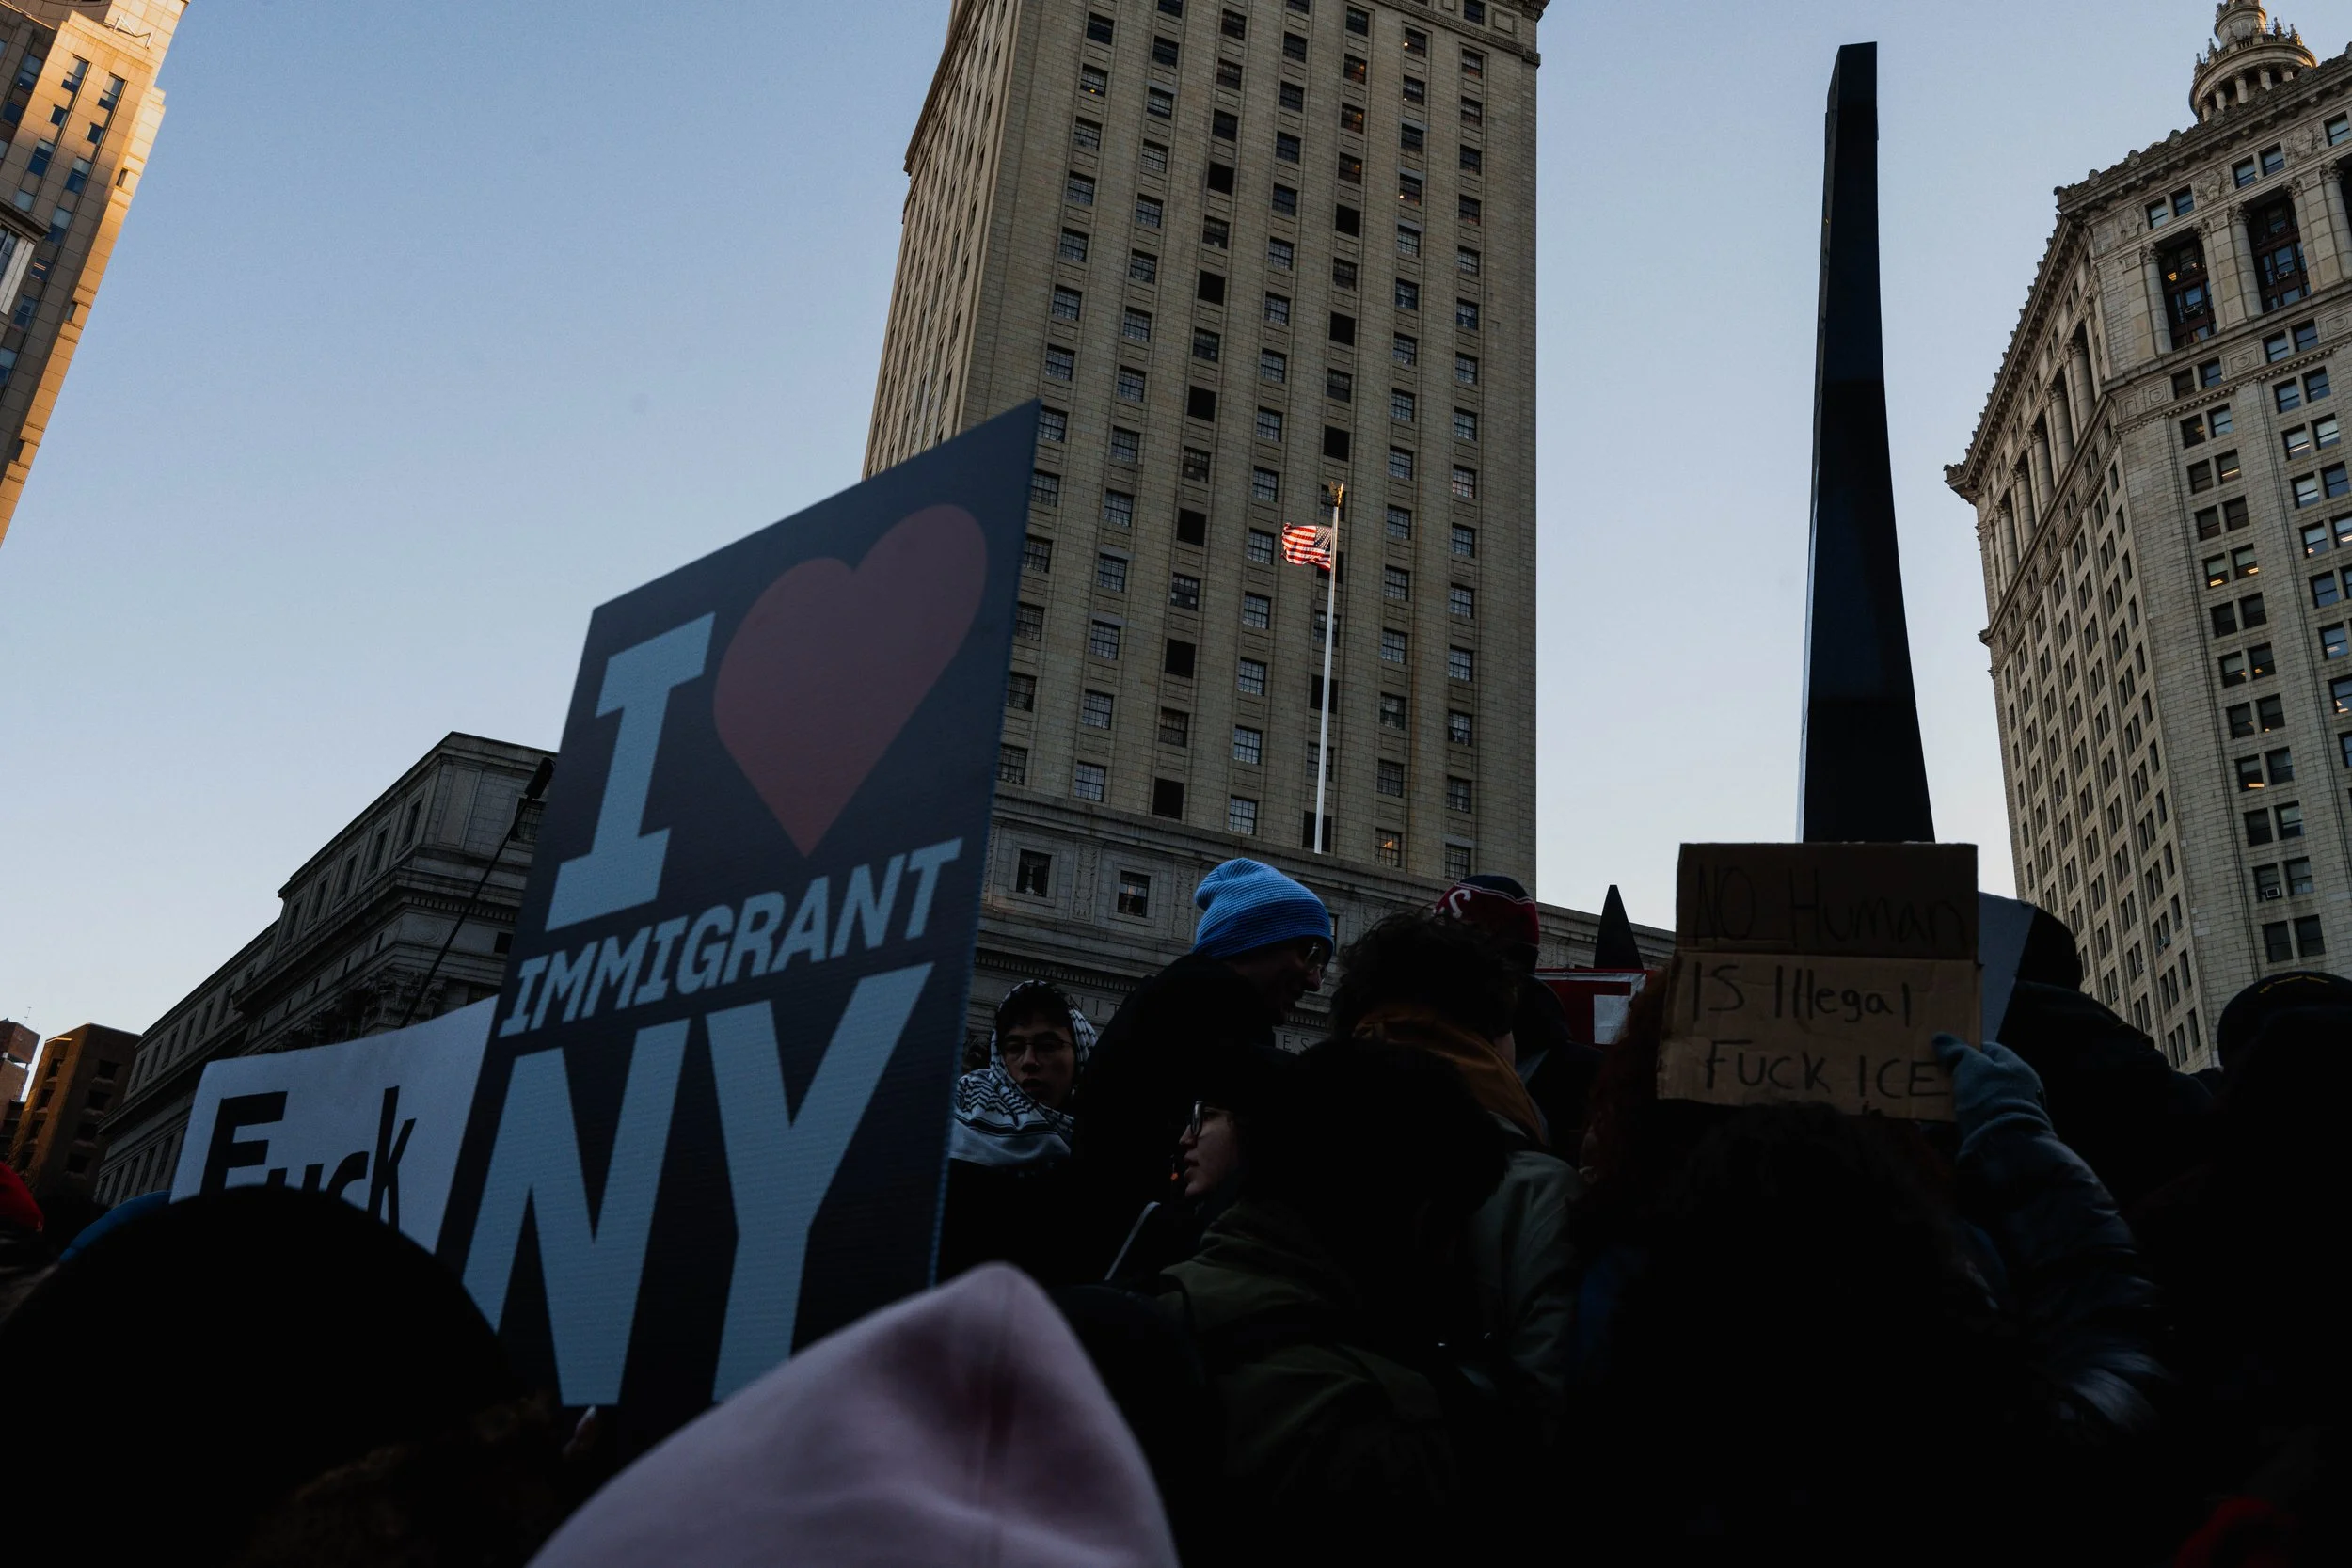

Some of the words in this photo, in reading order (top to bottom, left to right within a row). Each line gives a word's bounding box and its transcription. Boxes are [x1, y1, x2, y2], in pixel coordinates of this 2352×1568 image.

[546, 611, 716, 932] I
[498, 837, 963, 1038] IMMIGRANT
[1695, 865, 1756, 946] NO
[1788, 867, 1968, 948] Human
[1775, 966, 1912, 1027] Illegal
[1706, 1040, 1831, 1095] FUCK
[1859, 1055, 1949, 1099] ICE
[462, 961, 936, 1407] NY
